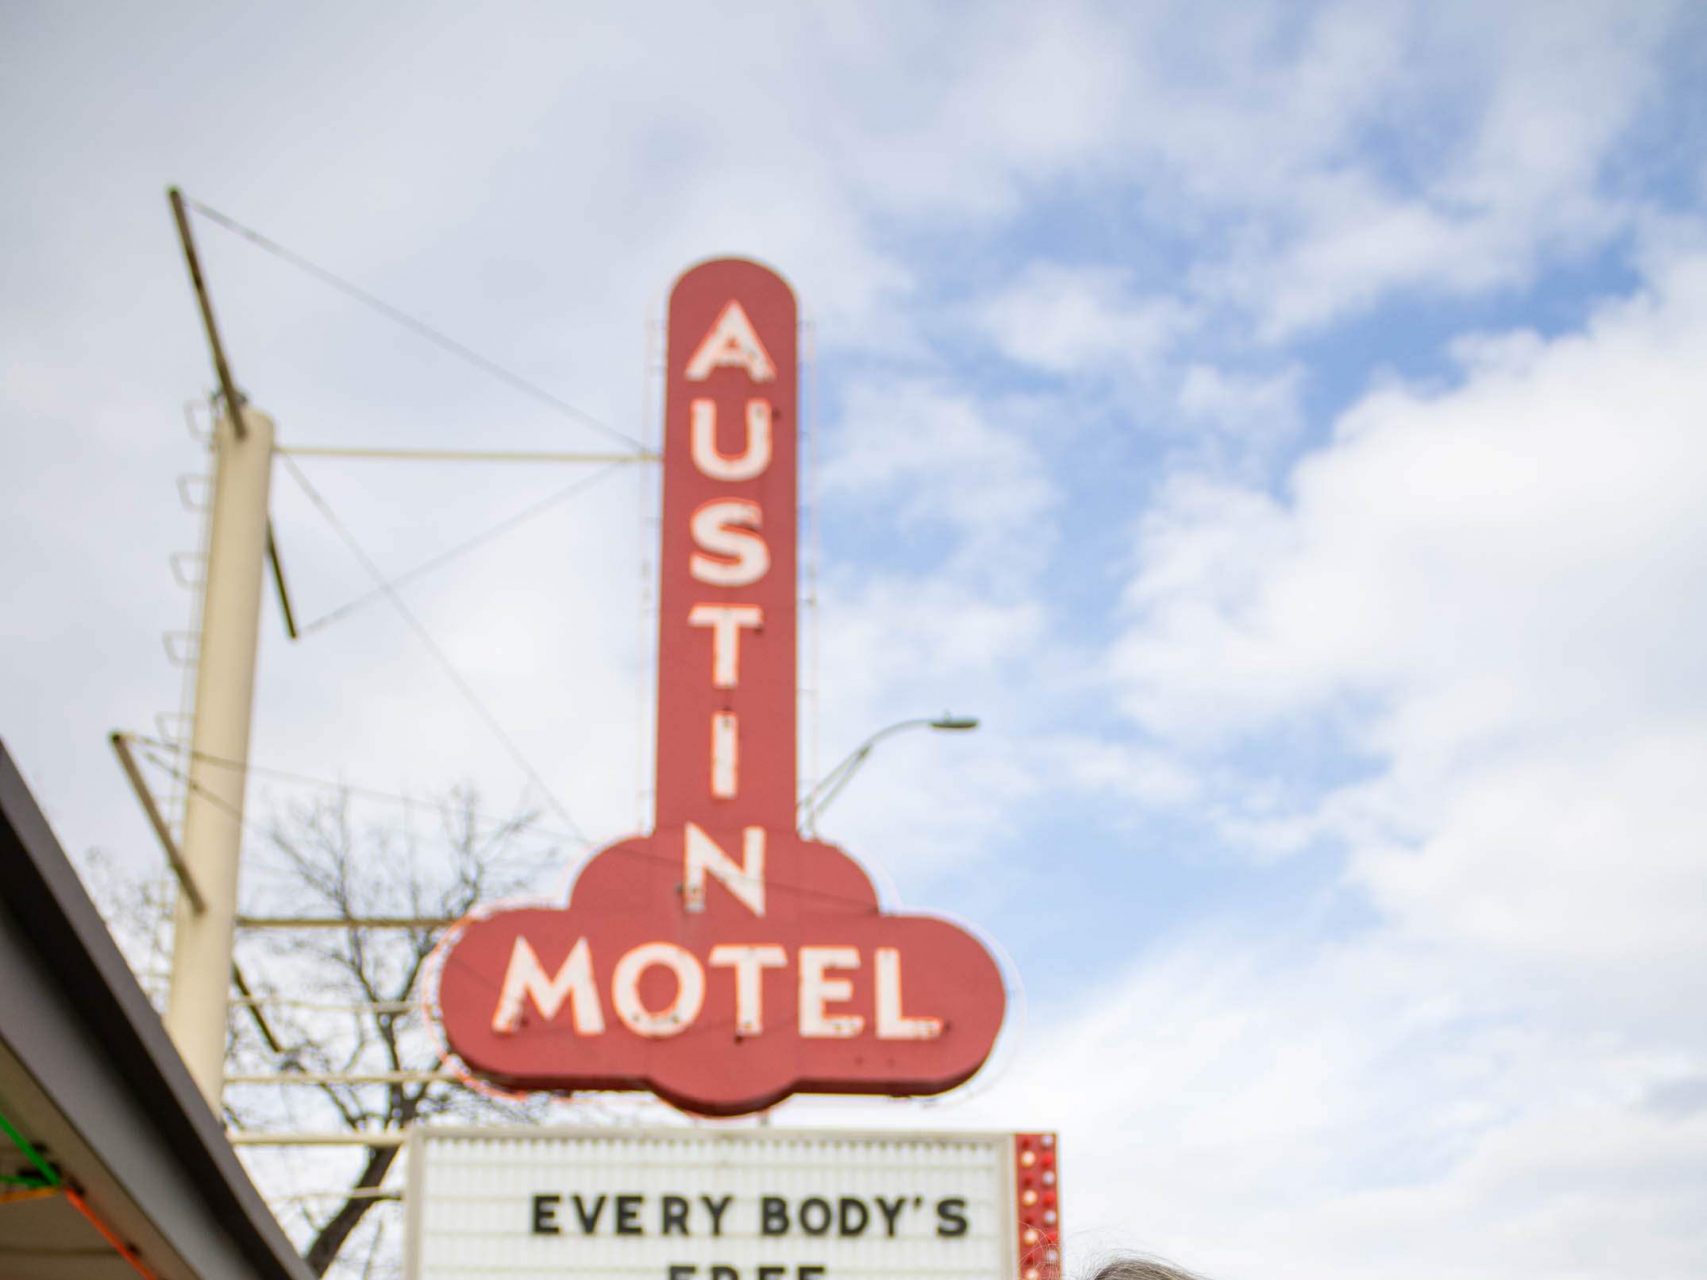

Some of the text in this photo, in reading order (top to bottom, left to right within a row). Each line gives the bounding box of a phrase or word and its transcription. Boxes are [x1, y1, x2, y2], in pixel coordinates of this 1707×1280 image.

[683, 299, 776, 918] AUSTIN
[491, 935, 944, 1040] MOTEL
[532, 1194, 968, 1238] EVERY BODY'S
